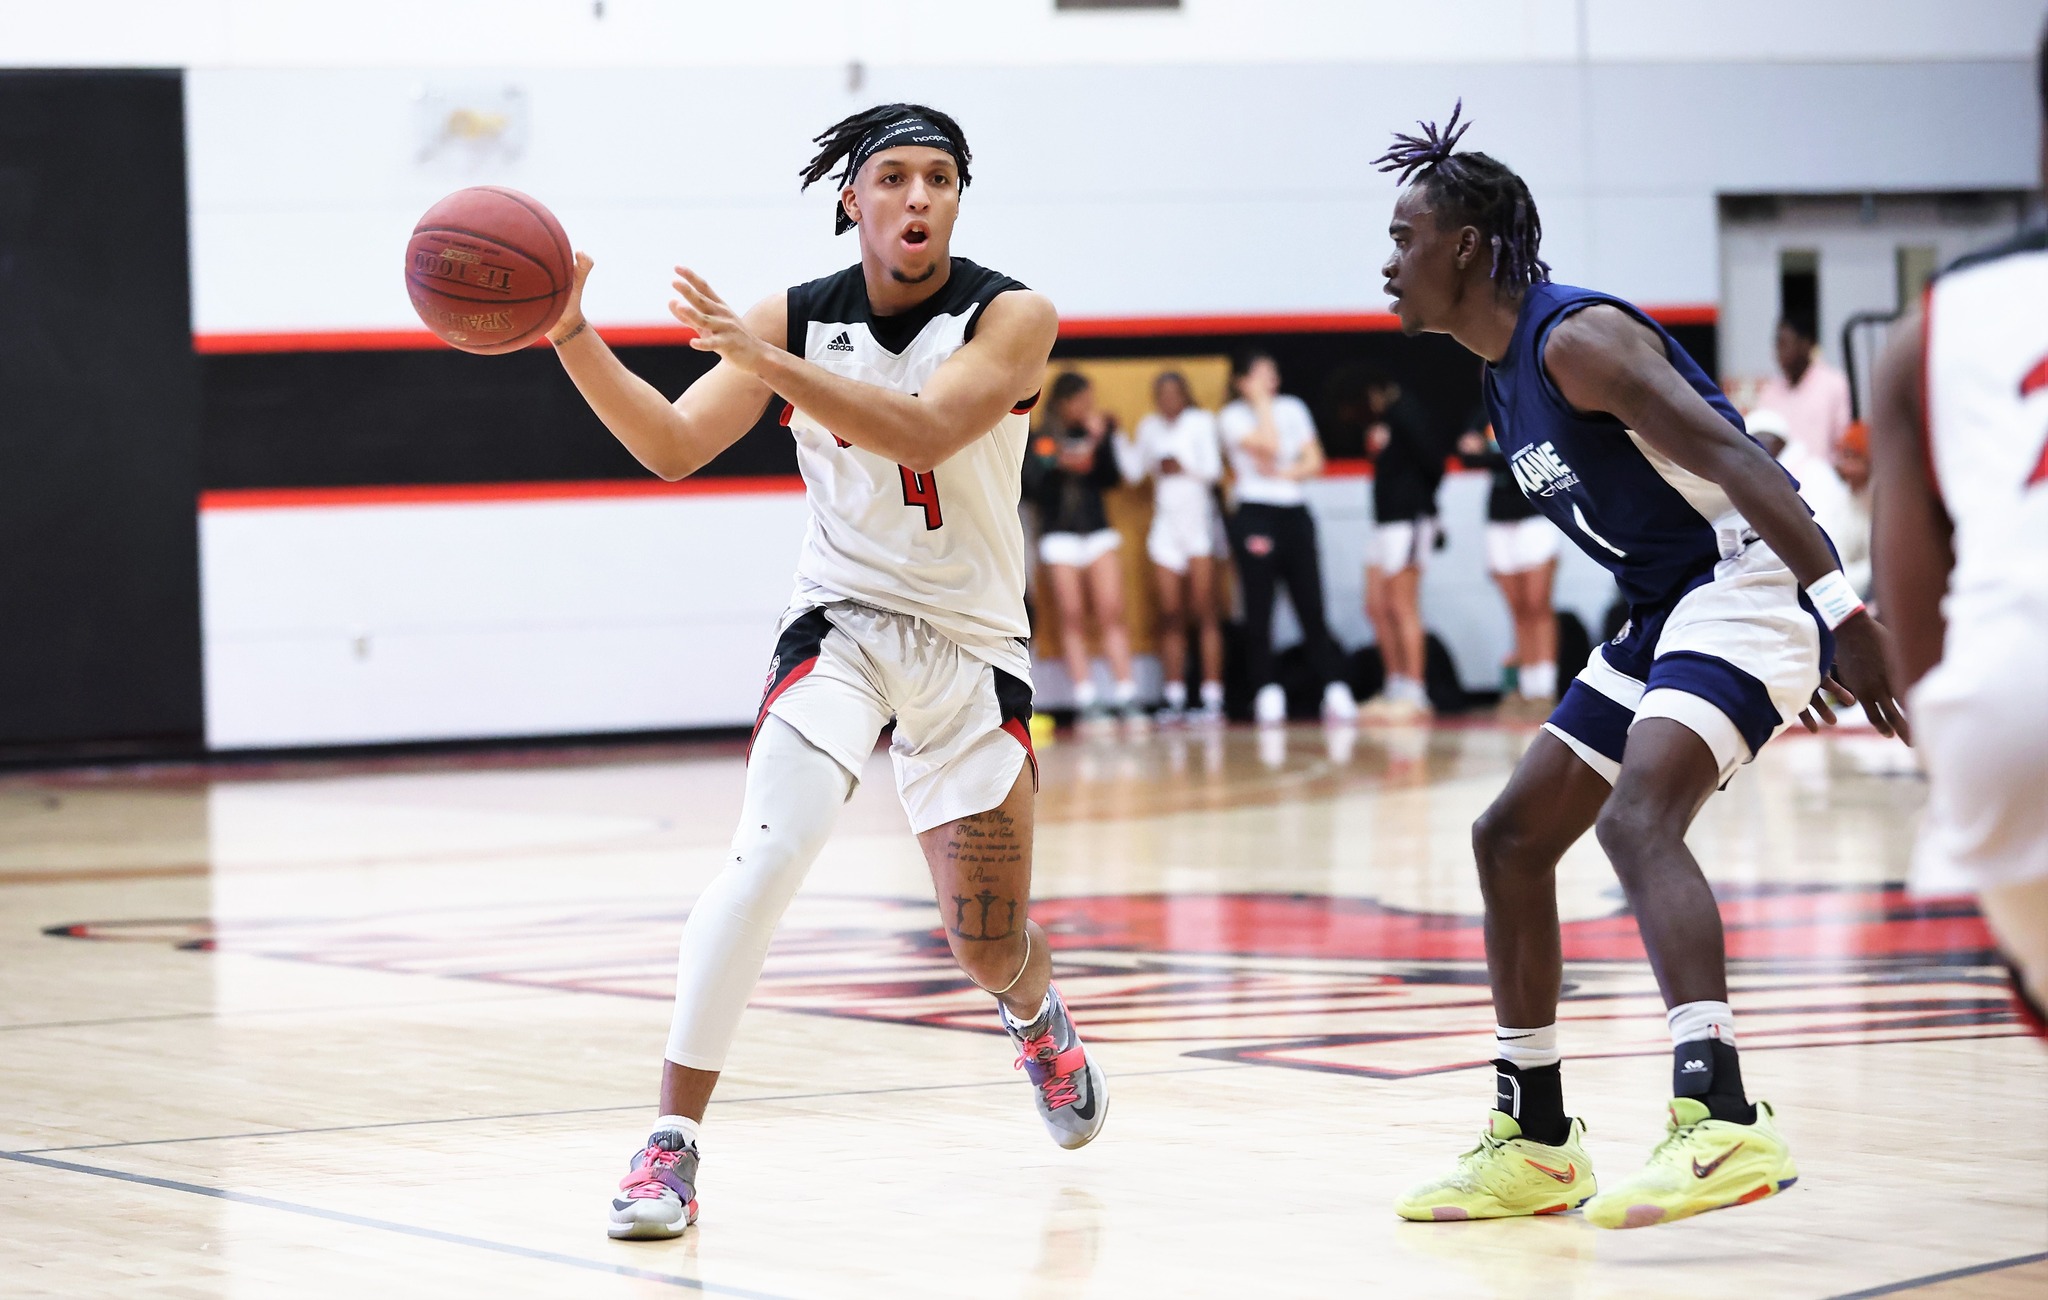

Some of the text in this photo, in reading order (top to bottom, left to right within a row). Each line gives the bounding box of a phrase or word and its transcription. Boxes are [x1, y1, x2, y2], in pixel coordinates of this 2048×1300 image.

[865, 125, 923, 156] hoopculture
[415, 252, 511, 290] TF-1000
[827, 343, 854, 351] adidas
[897, 463, 943, 531] 4
